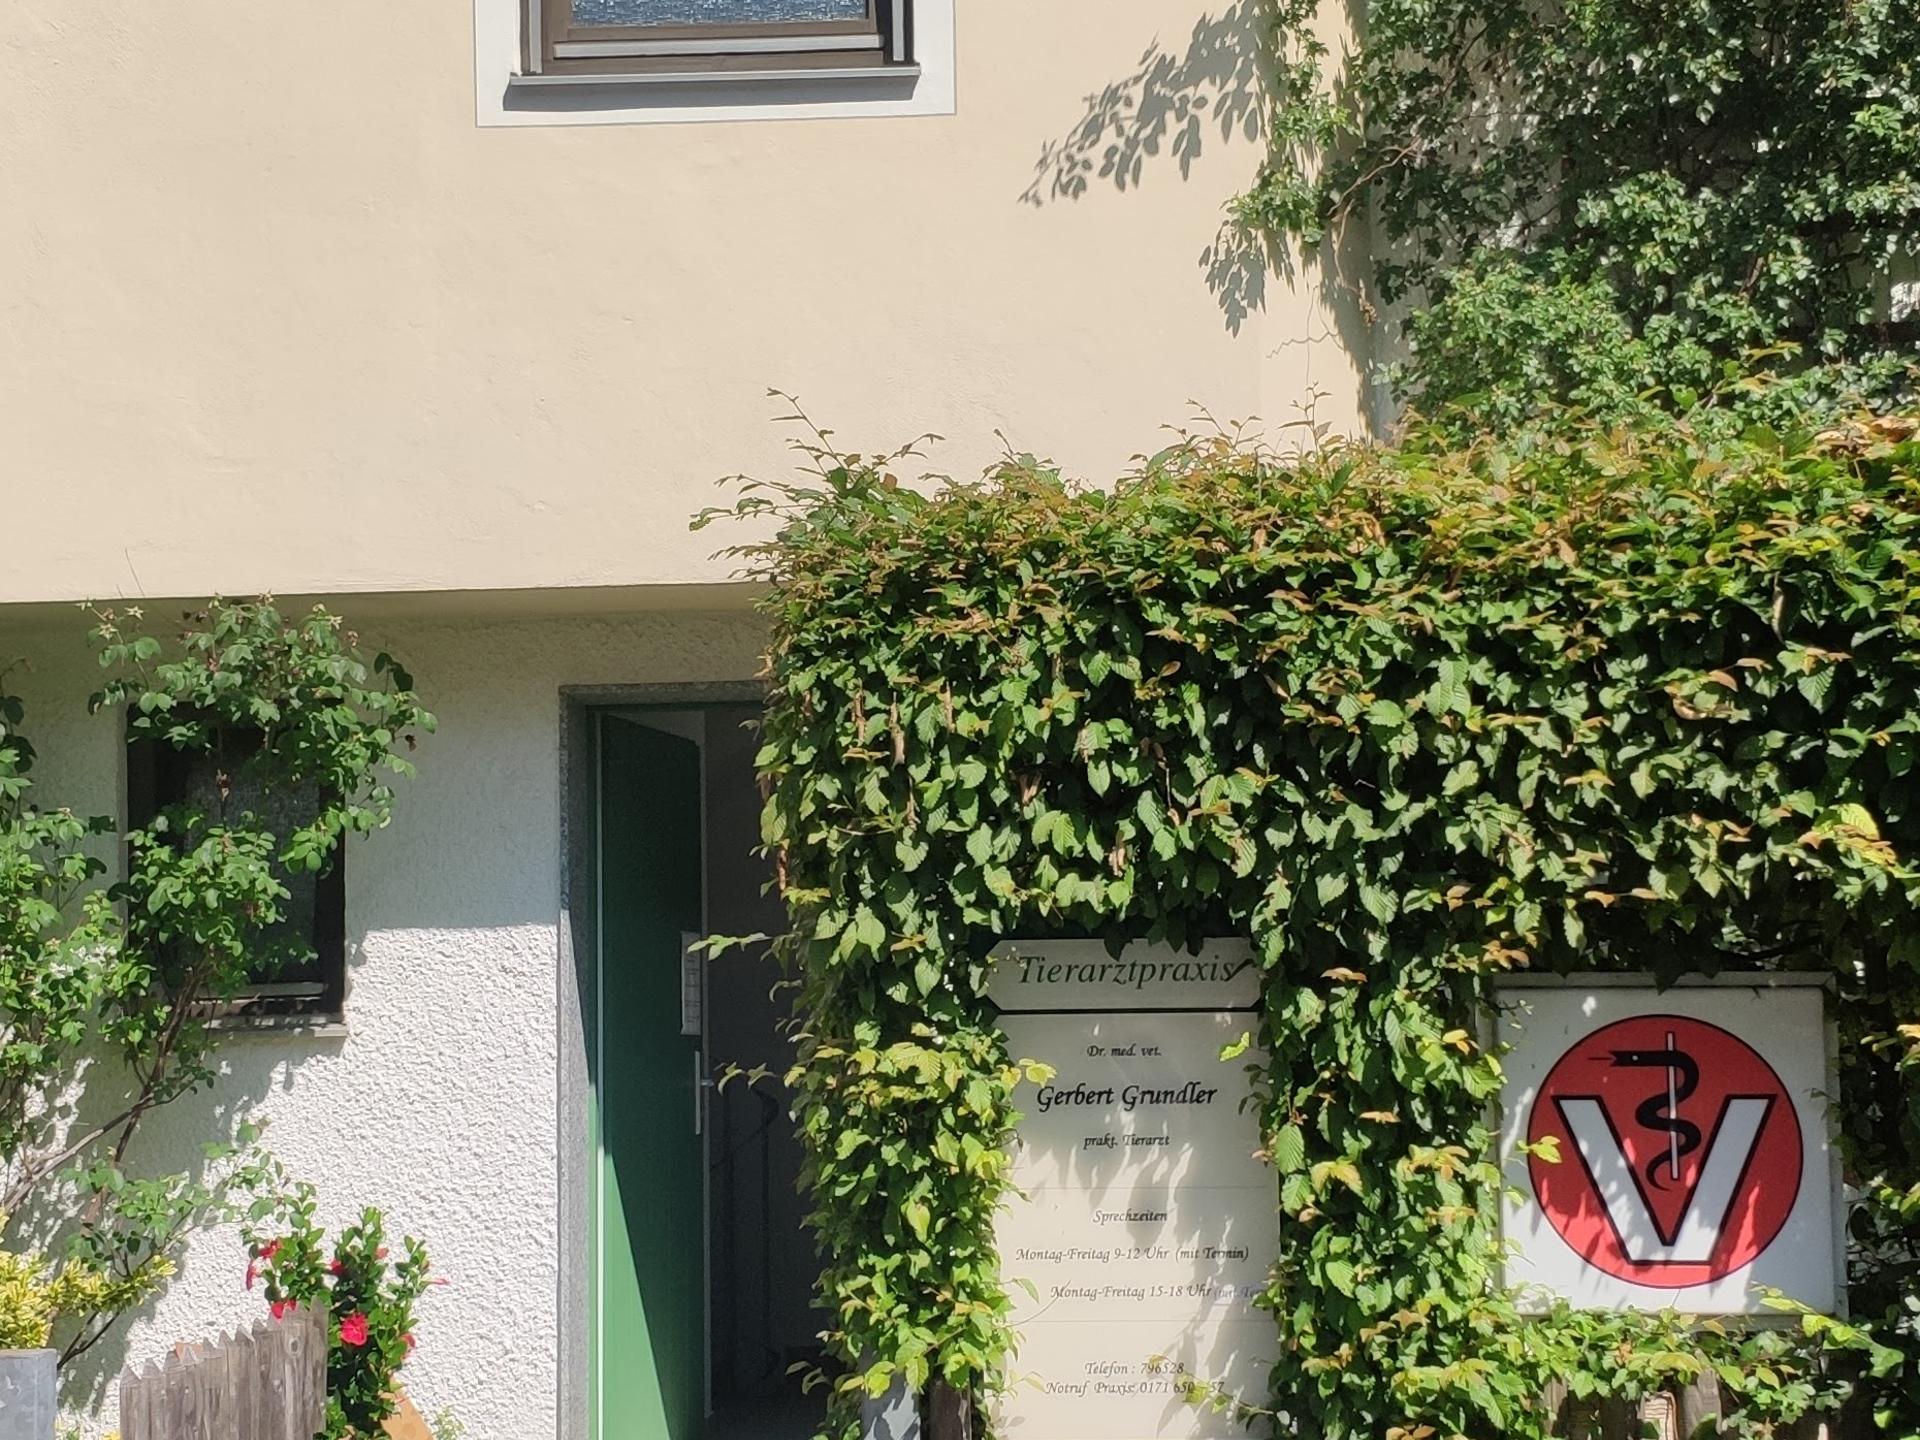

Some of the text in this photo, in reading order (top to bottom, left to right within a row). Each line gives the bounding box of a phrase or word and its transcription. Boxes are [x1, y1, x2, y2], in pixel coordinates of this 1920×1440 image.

[1018, 954, 1238, 989] Tierarztpraxis
[1087, 1044, 1162, 1058] Dr. med. vet.
[1036, 1081, 1218, 1113] Gerbert Grundler
[1083, 1132, 1170, 1150] prakt. Tierarzt
[1092, 1208, 1168, 1225] Sprechzeiten
[1015, 1245, 1249, 1264] Montag-Freitag 9-12 Uhr (mit Termin)
[1050, 1284, 1145, 1301] Montag-Freitag
[1149, 1285, 1183, 1298] 15-18
[1186, 1283, 1212, 1298] Uhr
[1084, 1361, 1129, 1377] Telefon
[1139, 1362, 1185, 1374] 796528
[1045, 1380, 1090, 1396] Notruf
[1093, 1381, 1136, 1396] Praxis:
[1139, 1381, 1168, 1394] 0171
